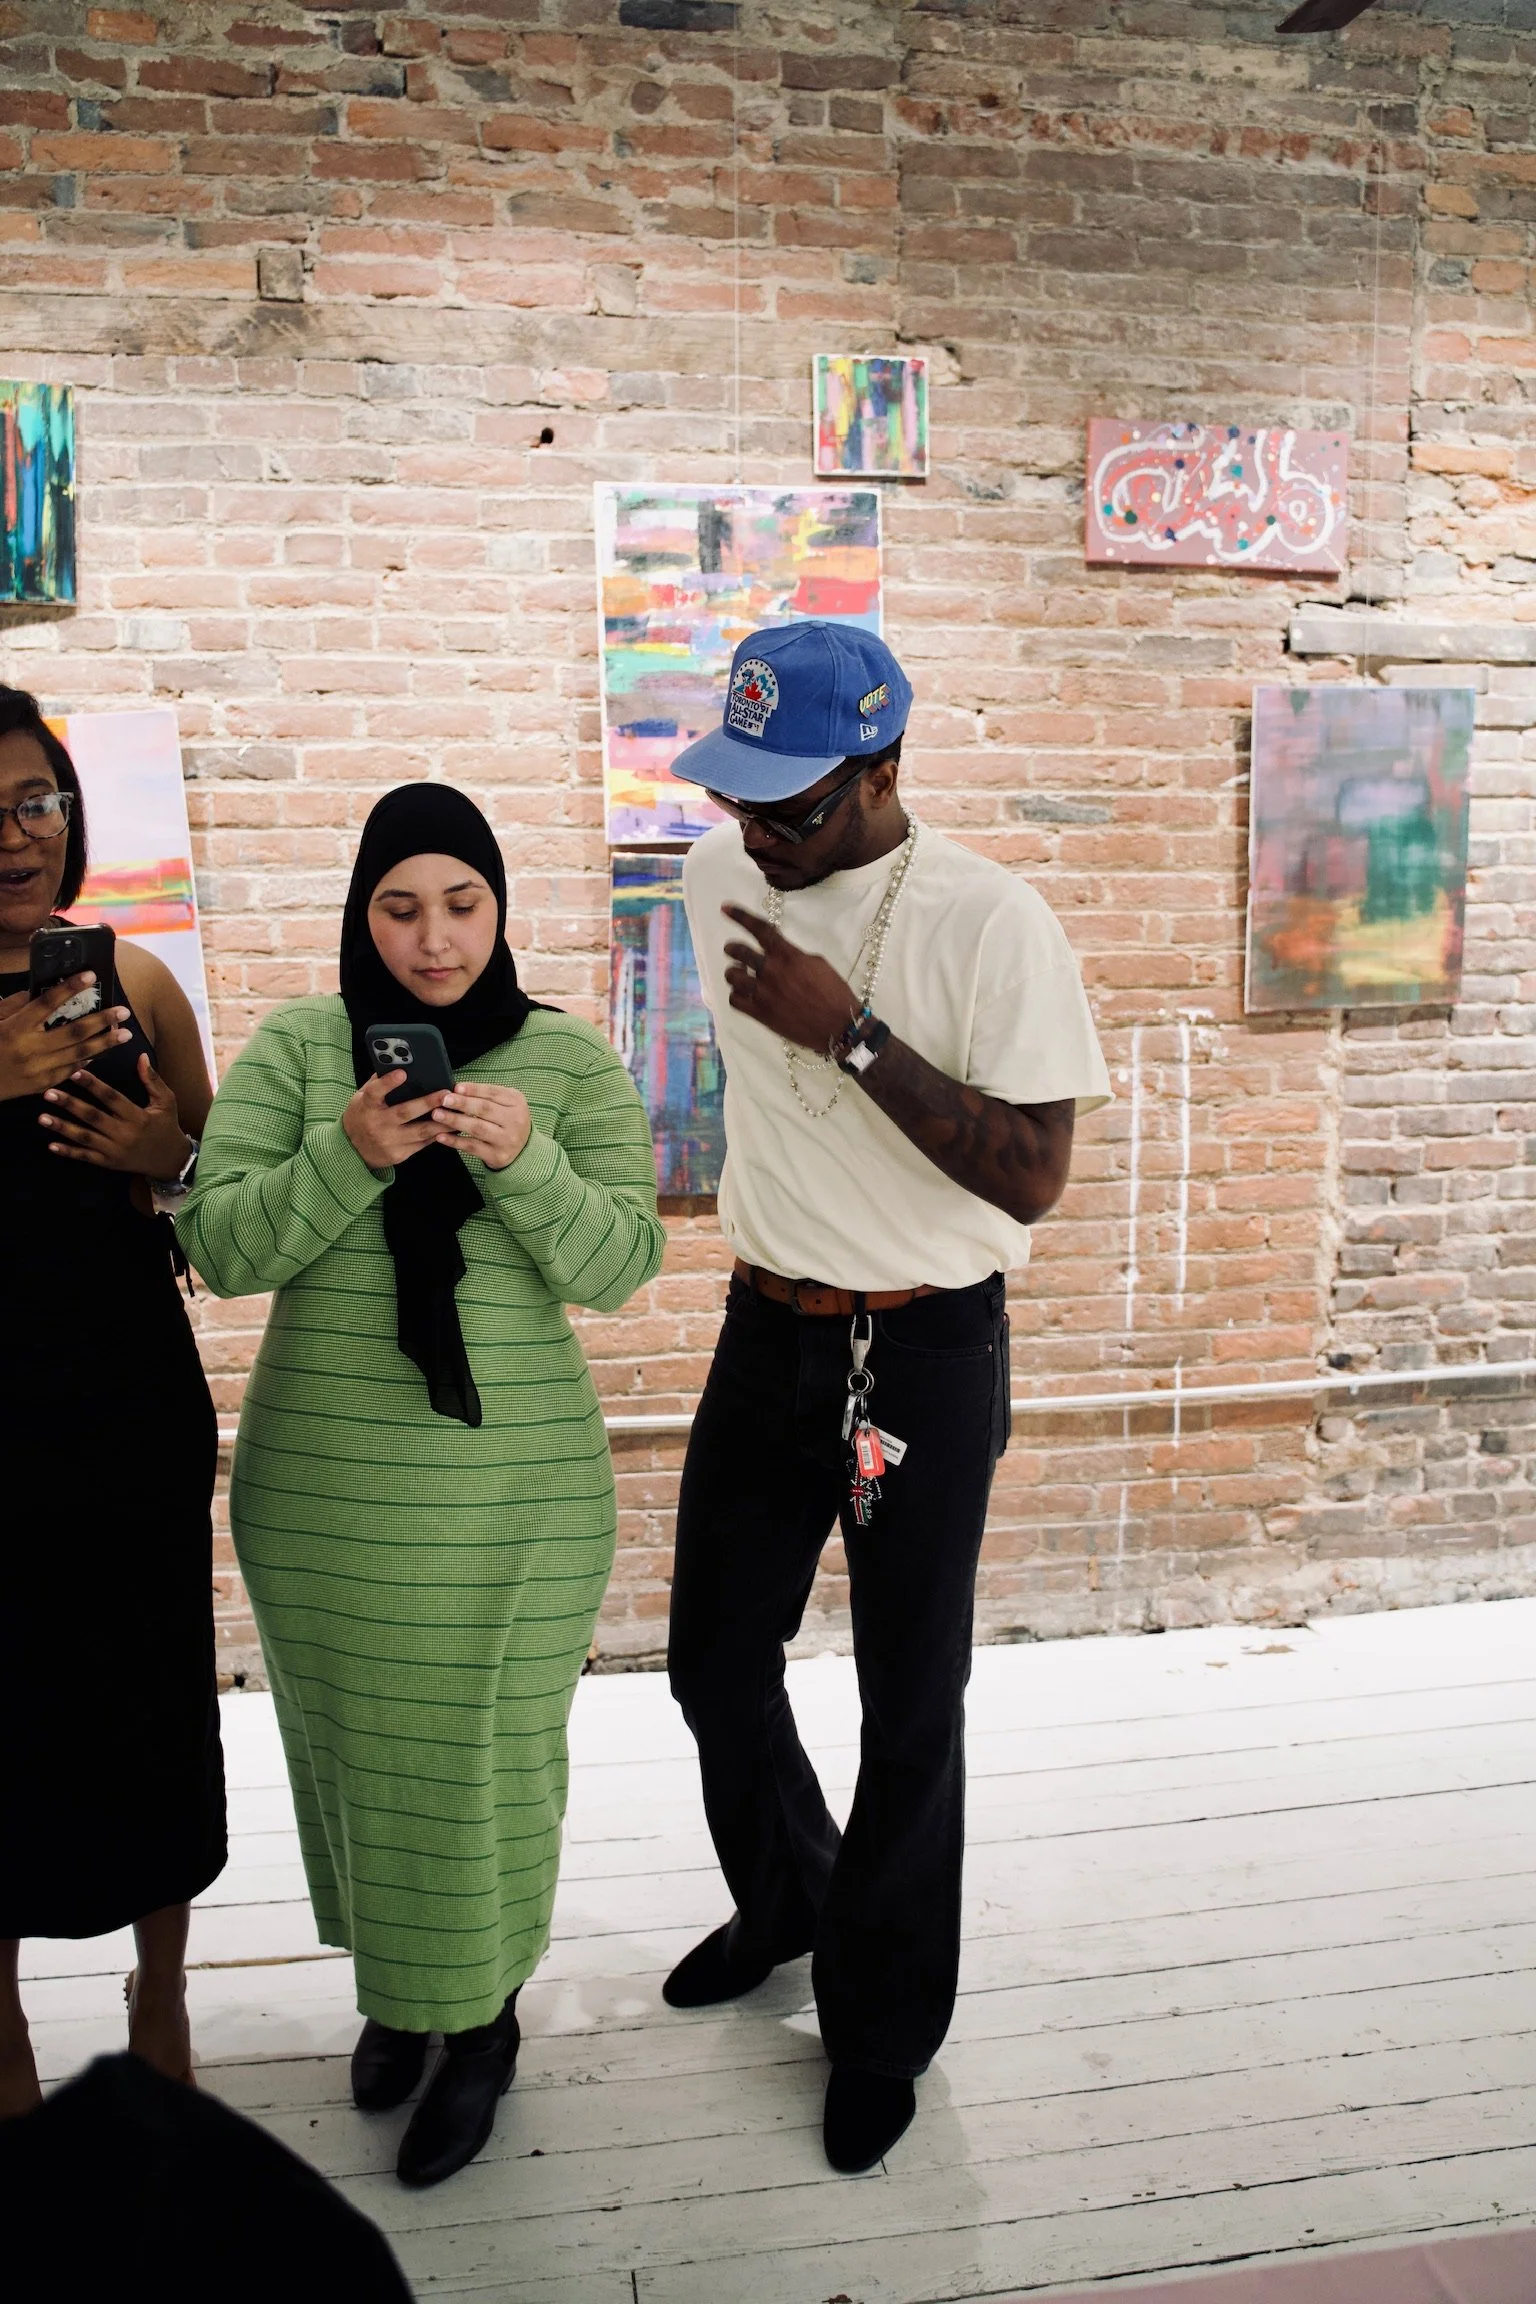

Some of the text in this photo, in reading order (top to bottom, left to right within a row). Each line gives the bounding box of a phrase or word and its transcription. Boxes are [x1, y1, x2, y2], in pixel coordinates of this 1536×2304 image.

[732, 692, 760, 711] TORONTO
[859, 682, 887, 713] VOTE
[730, 713, 748, 729] GAME
[731, 703, 764, 724] ALL-STAR
